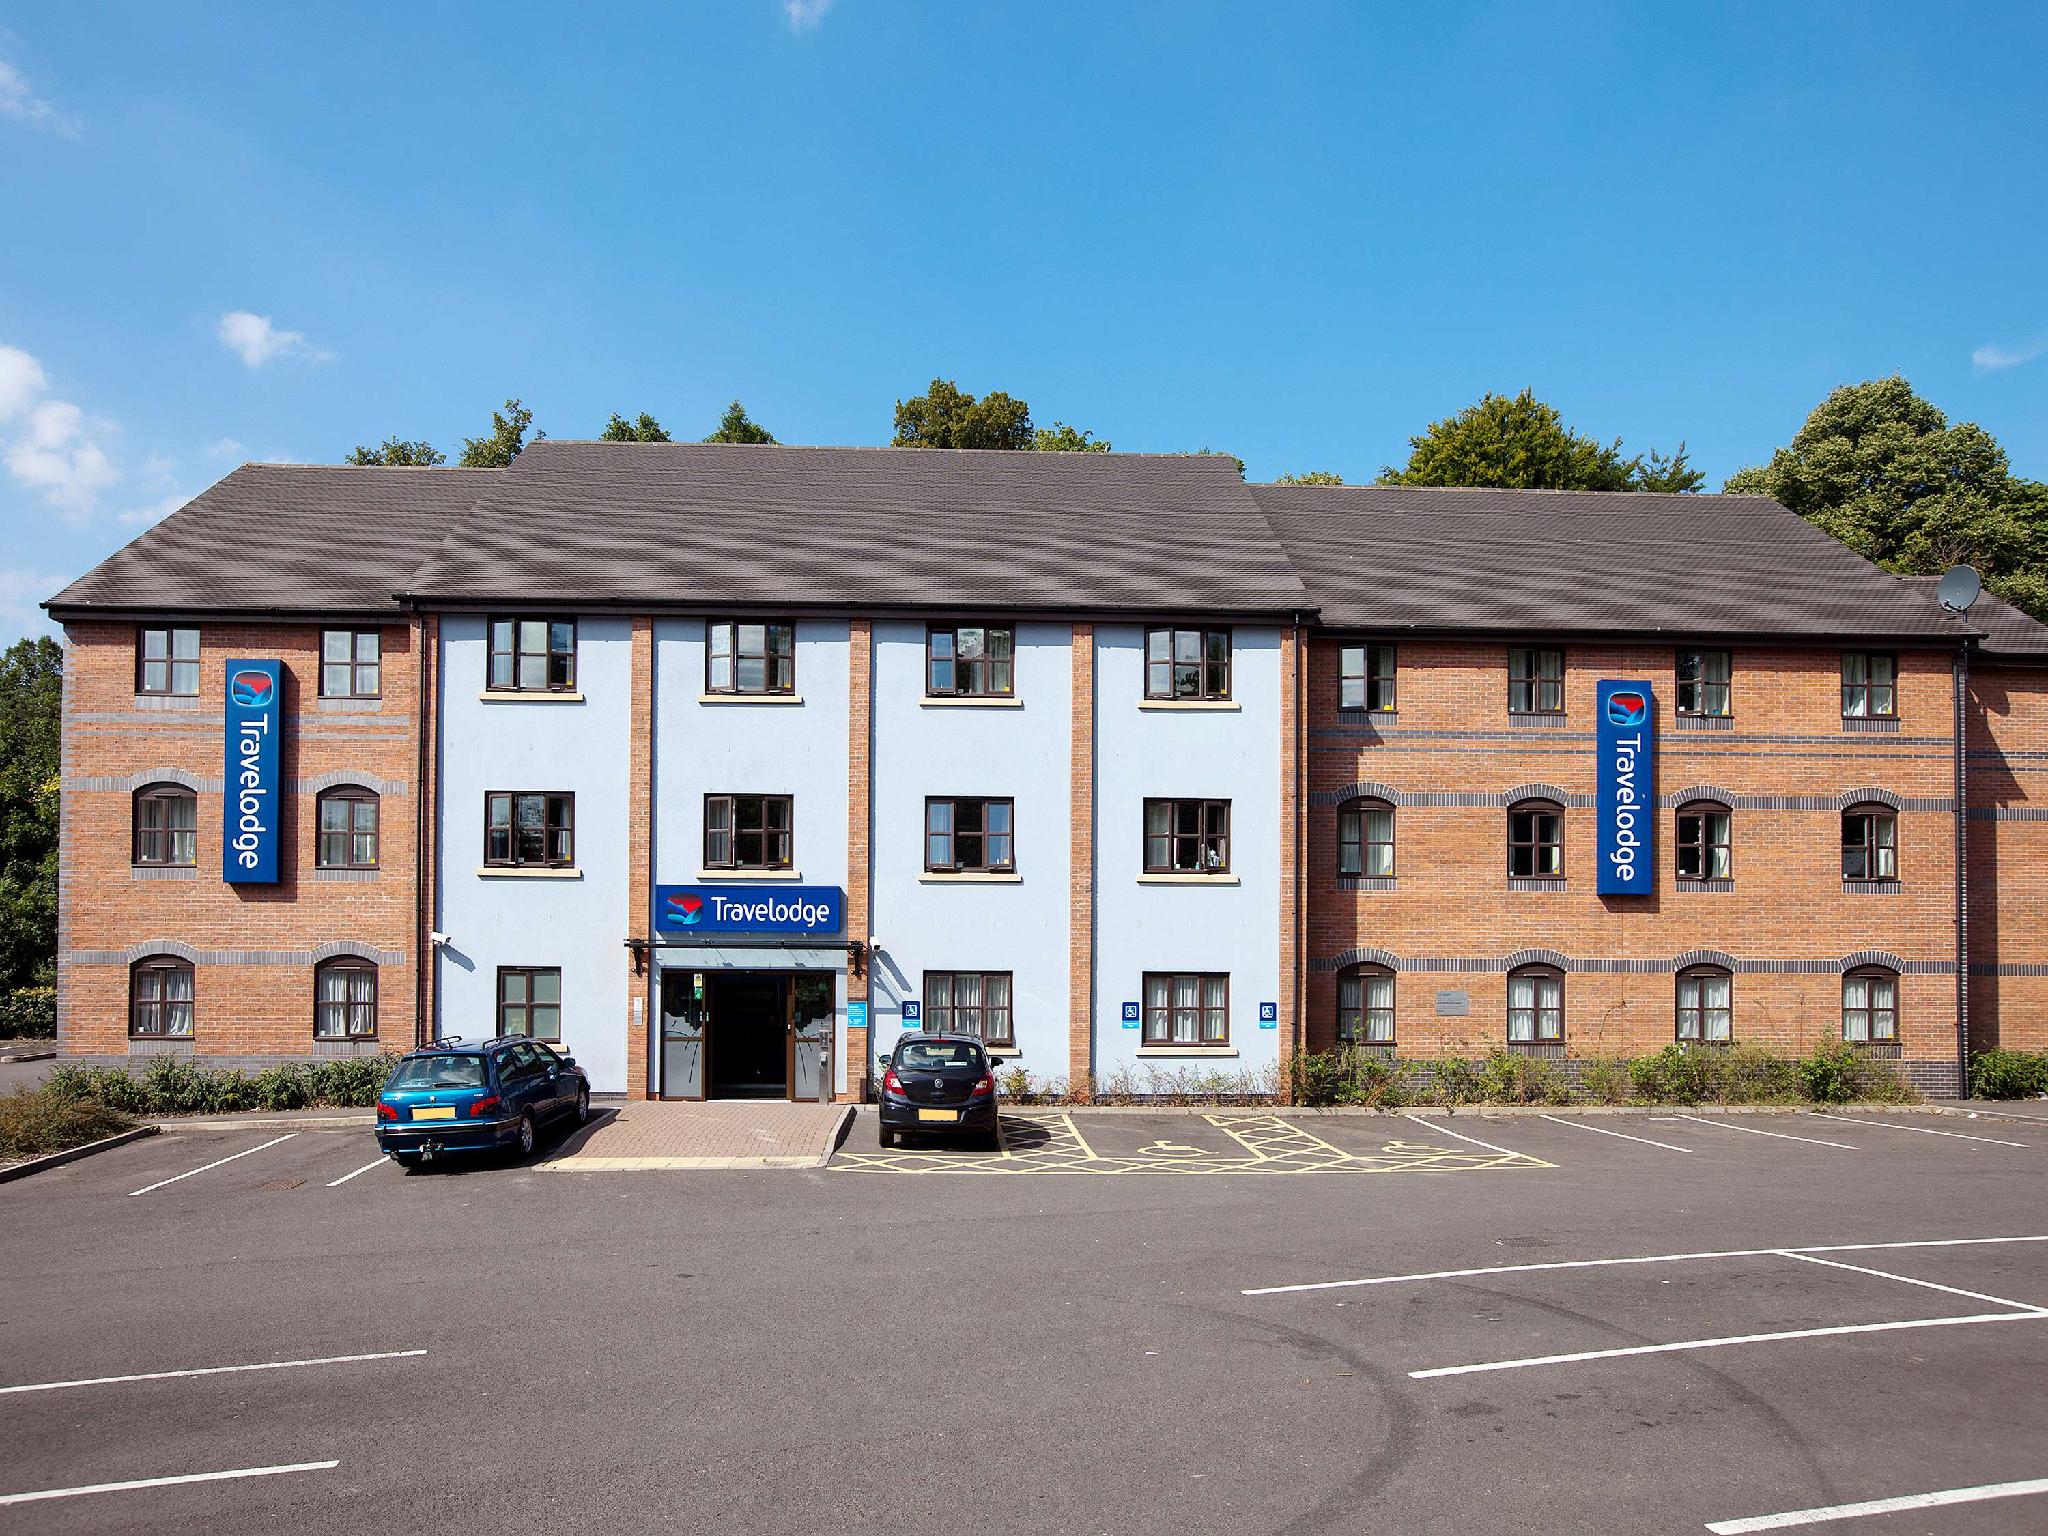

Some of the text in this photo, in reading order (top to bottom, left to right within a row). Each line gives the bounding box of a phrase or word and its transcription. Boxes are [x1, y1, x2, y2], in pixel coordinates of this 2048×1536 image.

[233, 712, 268, 869] Travelodge
[1610, 732, 1641, 882] Travelodge
[711, 896, 830, 928] Travelodge
